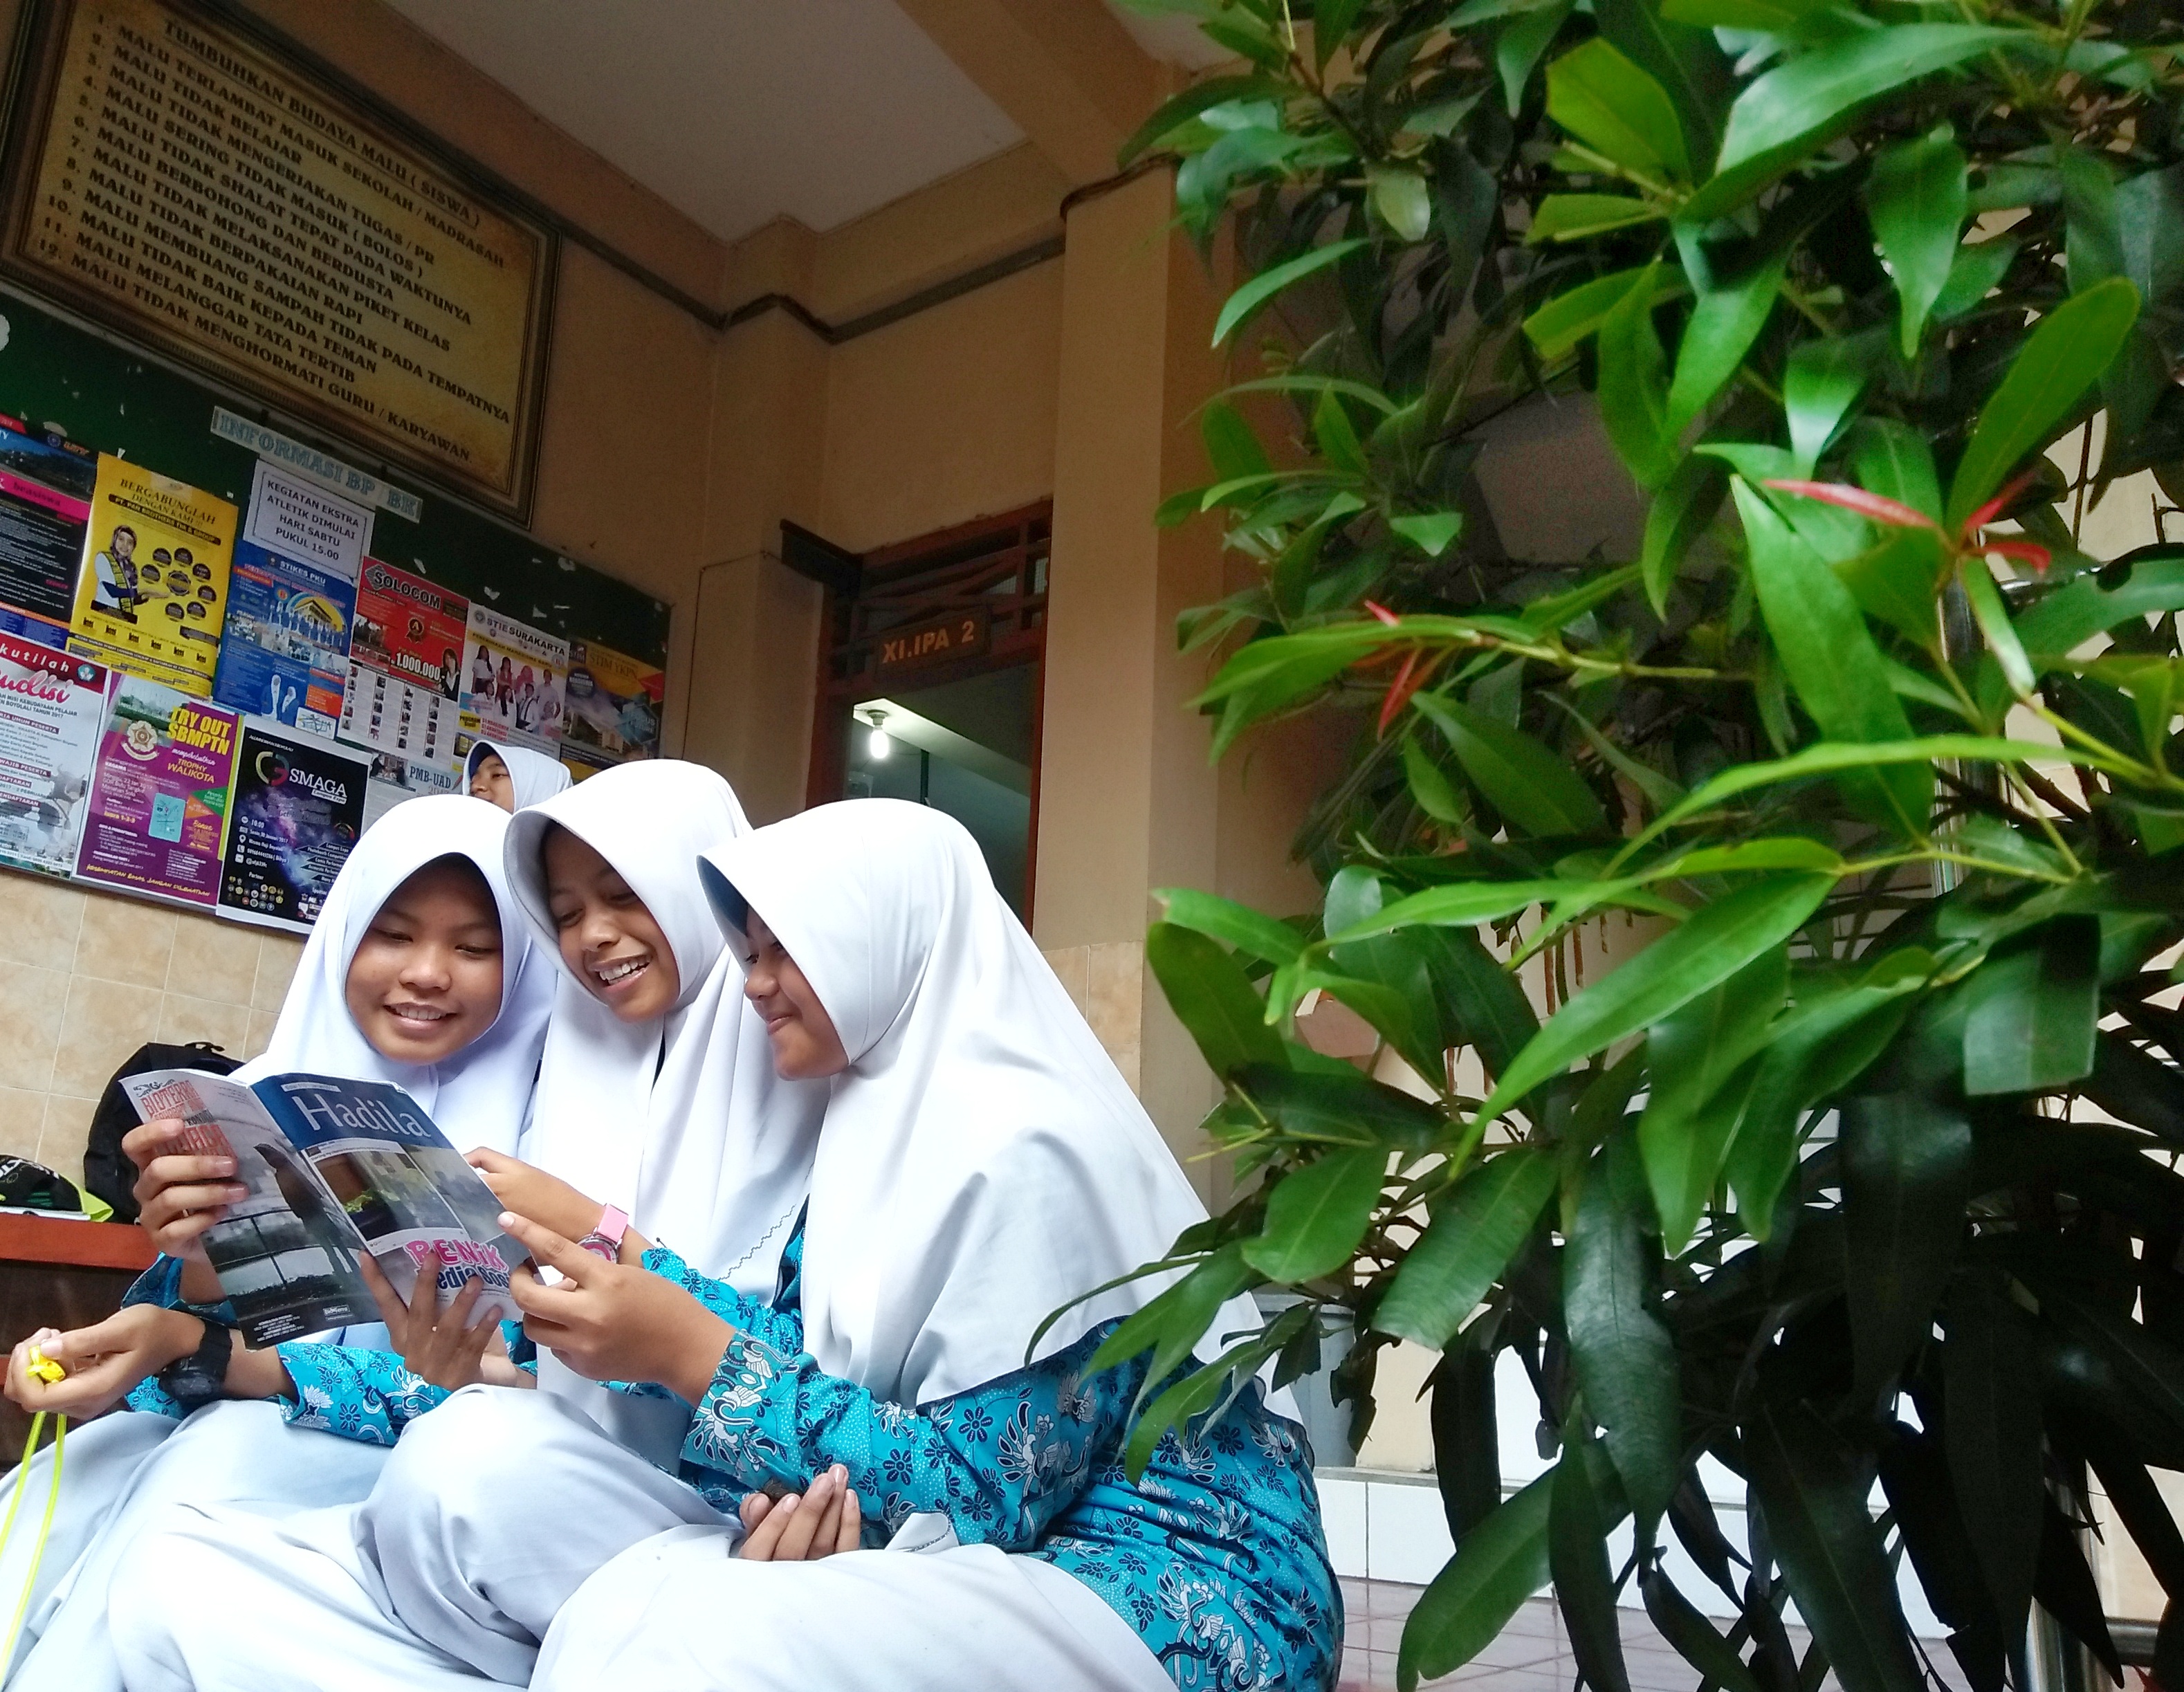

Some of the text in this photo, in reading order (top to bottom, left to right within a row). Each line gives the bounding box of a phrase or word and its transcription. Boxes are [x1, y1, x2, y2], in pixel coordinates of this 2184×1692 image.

[114, 44, 166, 85] MALU
[172, 79, 225, 120] TIDAK
[231, 113, 302, 165] BELAJAR
[165, 19, 470, 221] TUMBUHKAN BUDAYA MALU SISWA
[110, 64, 163, 104] MALU
[169, 98, 222, 140] TIDAK
[228, 134, 347, 212] MENGERJAKAN
[353, 207, 403, 244] TUGAS
[414, 244, 435, 265] PR
[120, 26, 169, 64] MALU
[176, 58, 276, 127] TERLAMBAT
[280, 123, 338, 166] MASUK
[342, 161, 414, 212] SEKOLAH
[425, 211, 504, 268] MADRASAH
[106, 84, 159, 125] MALU
[164, 118, 230, 166] SERING
[235, 158, 287, 199] TIDAK
[291, 192, 350, 235] MASUK
[362, 235, 414, 274] BOLOS
[98, 127, 151, 165] MALU
[156, 159, 268, 230] BERBOHONG
[272, 223, 307, 252] DAN
[311, 246, 394, 302] BERDUSTA
[102, 105, 156, 145] MALU
[160, 138, 215, 180] TIDAK
[219, 174, 287, 219] SHALAT
[290, 210, 340, 249] TEPAT
[343, 242, 385, 277] PADA
[390, 269, 472, 326] WAKTUNYA
[89, 169, 143, 206] MALU
[149, 199, 205, 240] TIDAK
[210, 233, 320, 301] BERPAKAIAN
[323, 295, 363, 324] RAPI
[93, 147, 147, 186] MALU
[153, 178, 208, 220] TIDAK
[212, 212, 348, 296] MELAKSANAKAN
[354, 291, 400, 324] PIKET
[404, 318, 450, 352] KELAS
[76, 232, 130, 270] MALU
[137, 264, 248, 329] MELANGGAR
[254, 322, 292, 352] TATA
[299, 345, 355, 383] TERTIB
[80, 211, 135, 248] MALU
[141, 241, 196, 281] TIDAK
[202, 274, 245, 306] BAIK
[250, 298, 317, 343] KEPADA
[323, 336, 376, 374] TEMAN
[85, 188, 139, 227] MALU
[145, 221, 248, 285] MEMBUANG
[253, 279, 325, 326] SAMPAH
[329, 319, 378, 353] TIDAK
[382, 347, 423, 378] PADA
[428, 370, 510, 424] TEMPATNYA
[71, 254, 127, 290] MALU
[134, 284, 188, 322] TIDAK
[194, 315, 323, 389] MENGHORMATI
[328, 383, 375, 414] GURU
[219, 414, 417, 517] INFORMASI BP BK
[120, 479, 216, 524] BERGABUNGLAH
[132, 493, 194, 524] DENGAN KAMI
[266, 479, 359, 528] KEGIATAN EKSTRA
[266, 495, 355, 541] ATLETIK DIMULAI
[275, 527, 340, 561] PUKUL 15.00
[279, 513, 340, 546] HARI SABTU
[280, 560, 308, 577] STIKES
[310, 572, 326, 585] PKU
[374, 571, 441, 610] SOLOCOM
[487, 618, 508, 632] STIE
[509, 627, 565, 656] SURAKARTA
[883, 620, 975, 663] XI.IPA 2
[6, 701, 32, 711] BOYOLALI
[33, 707, 51, 715] TAHUN
[12, 716, 56, 733] UMUM PESERTA
[19, 697, 54, 710] KEBUDAYAAN
[55, 707, 77, 716] PELAJAR
[171, 707, 232, 738] TRY OUT
[167, 723, 230, 755] SBMPTN
[21, 764, 47, 776] PESERTA
[167, 763, 215, 784] WALIKOTA
[178, 758, 207, 773] TROPHY
[288, 769, 347, 798] SMAGA
[410, 766, 451, 789] PMB-UAD
[291, 1094, 432, 1137] Hadilla
[419, 1266, 478, 1290] edia
